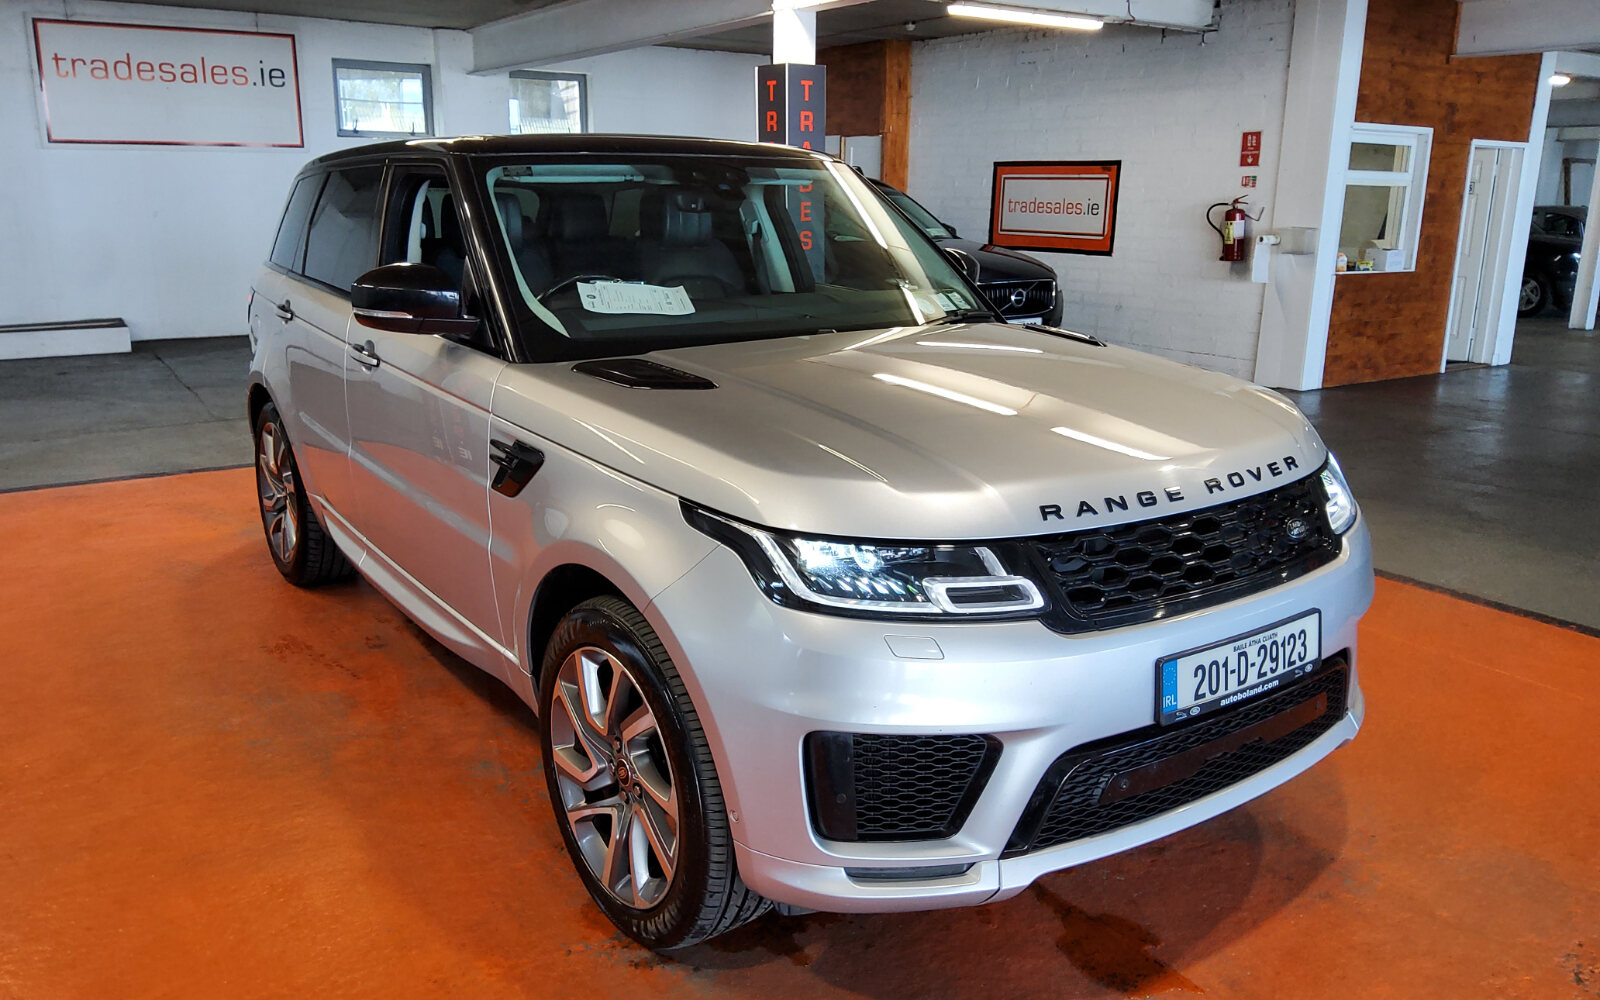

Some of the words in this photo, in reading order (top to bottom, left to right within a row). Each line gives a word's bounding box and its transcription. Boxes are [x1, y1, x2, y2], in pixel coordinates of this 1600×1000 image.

[52, 53, 286, 88] tradesales.ie
[1008, 197, 1100, 216] tradesales.ie
[1039, 486, 1184, 521] RANGE
[1204, 456, 1298, 494] ROVER
[1193, 629, 1307, 701] 201-D-29123
[1163, 693, 1177, 709] IRL
[1220, 679, 1279, 706] autoboland.com
